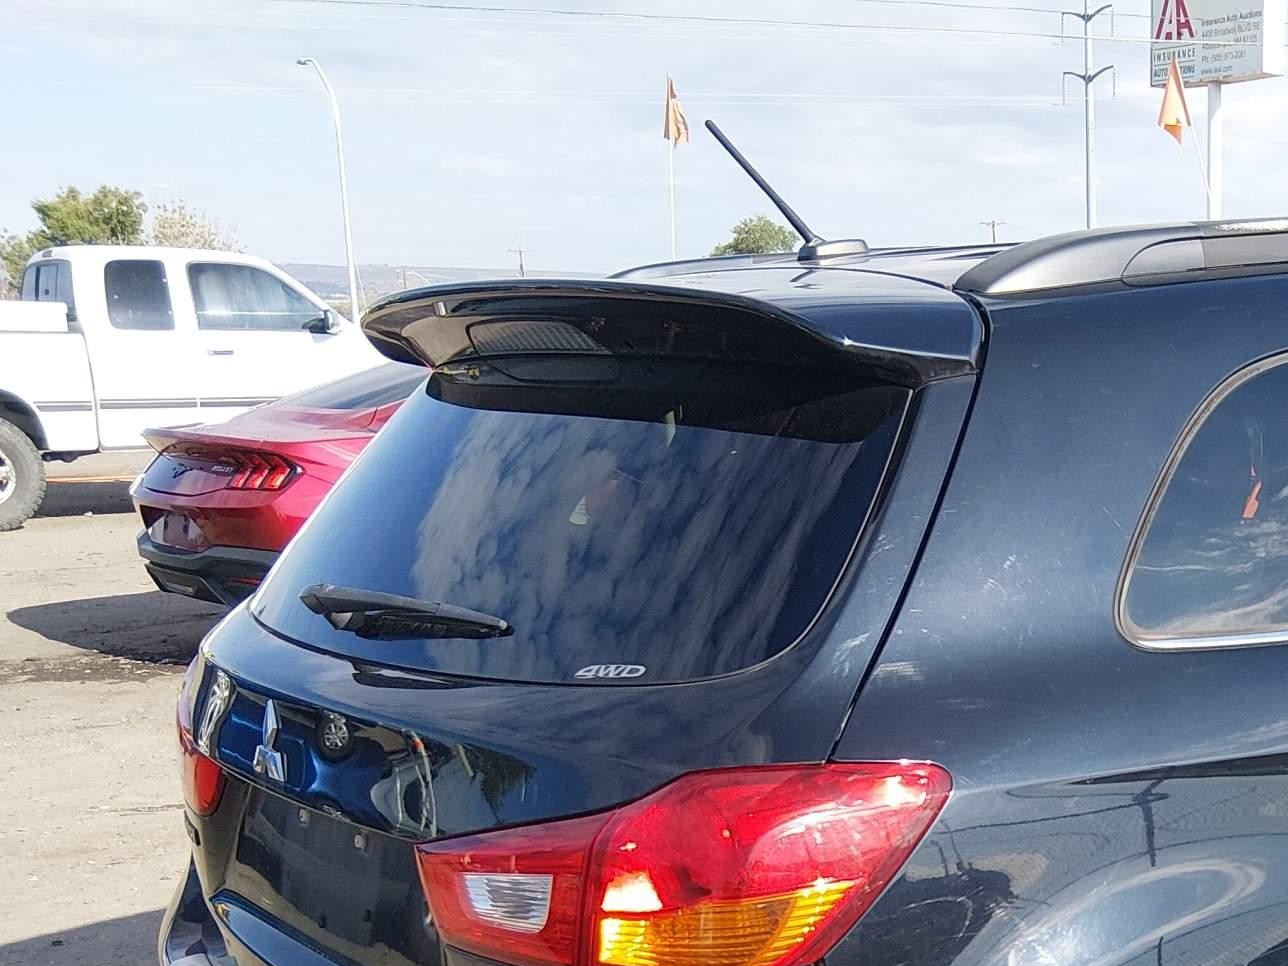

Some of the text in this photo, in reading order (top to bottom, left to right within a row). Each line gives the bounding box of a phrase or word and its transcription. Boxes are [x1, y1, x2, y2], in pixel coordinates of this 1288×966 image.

[1226, 14, 1238, 23] Auto
[1238, 9, 1262, 20] Auctions
[1153, 48, 1195, 62] INSURANCE
[574, 664, 646, 679] 4WD
